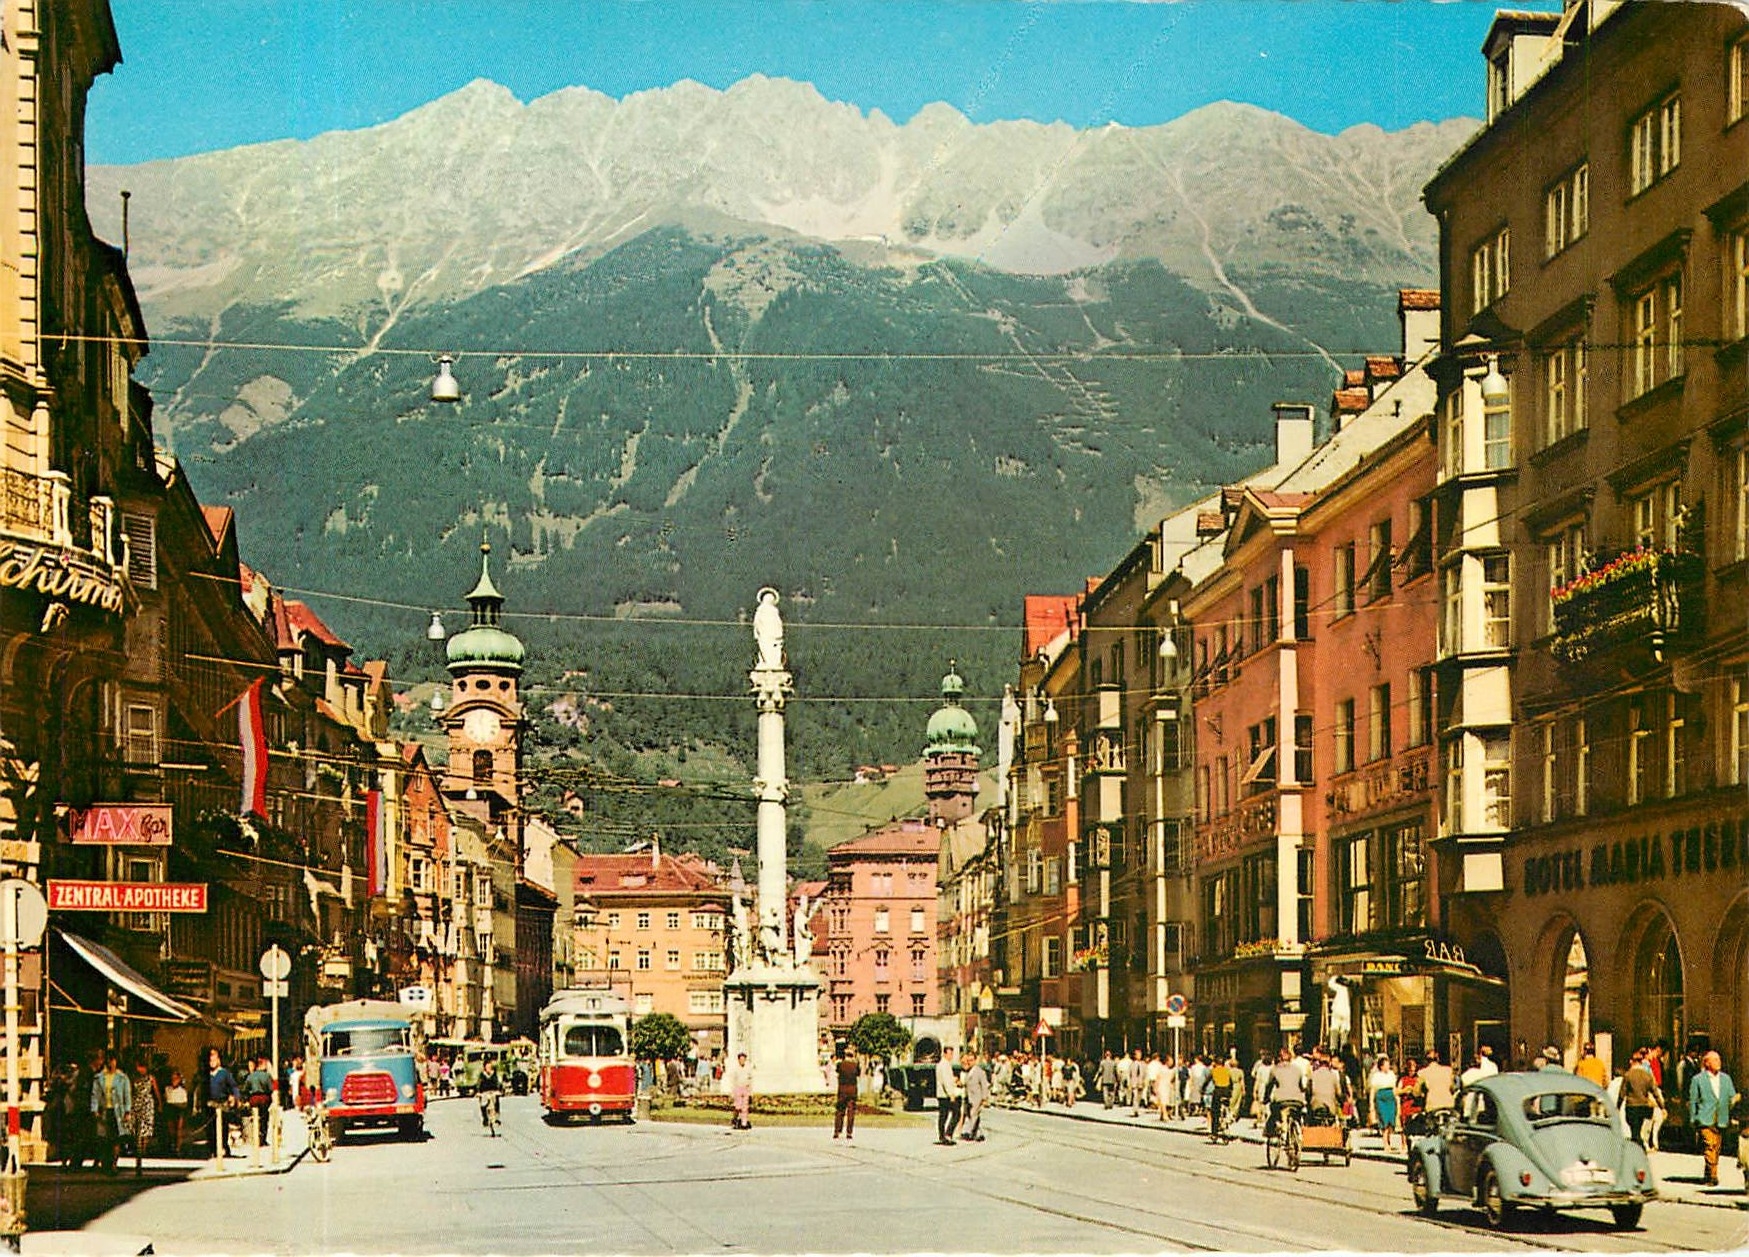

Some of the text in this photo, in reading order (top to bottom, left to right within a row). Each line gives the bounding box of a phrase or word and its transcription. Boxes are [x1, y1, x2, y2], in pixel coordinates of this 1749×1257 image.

[69, 808, 140, 840] MAX
[1524, 849, 1584, 898] HOTEL
[1589, 833, 1667, 888] MARIA
